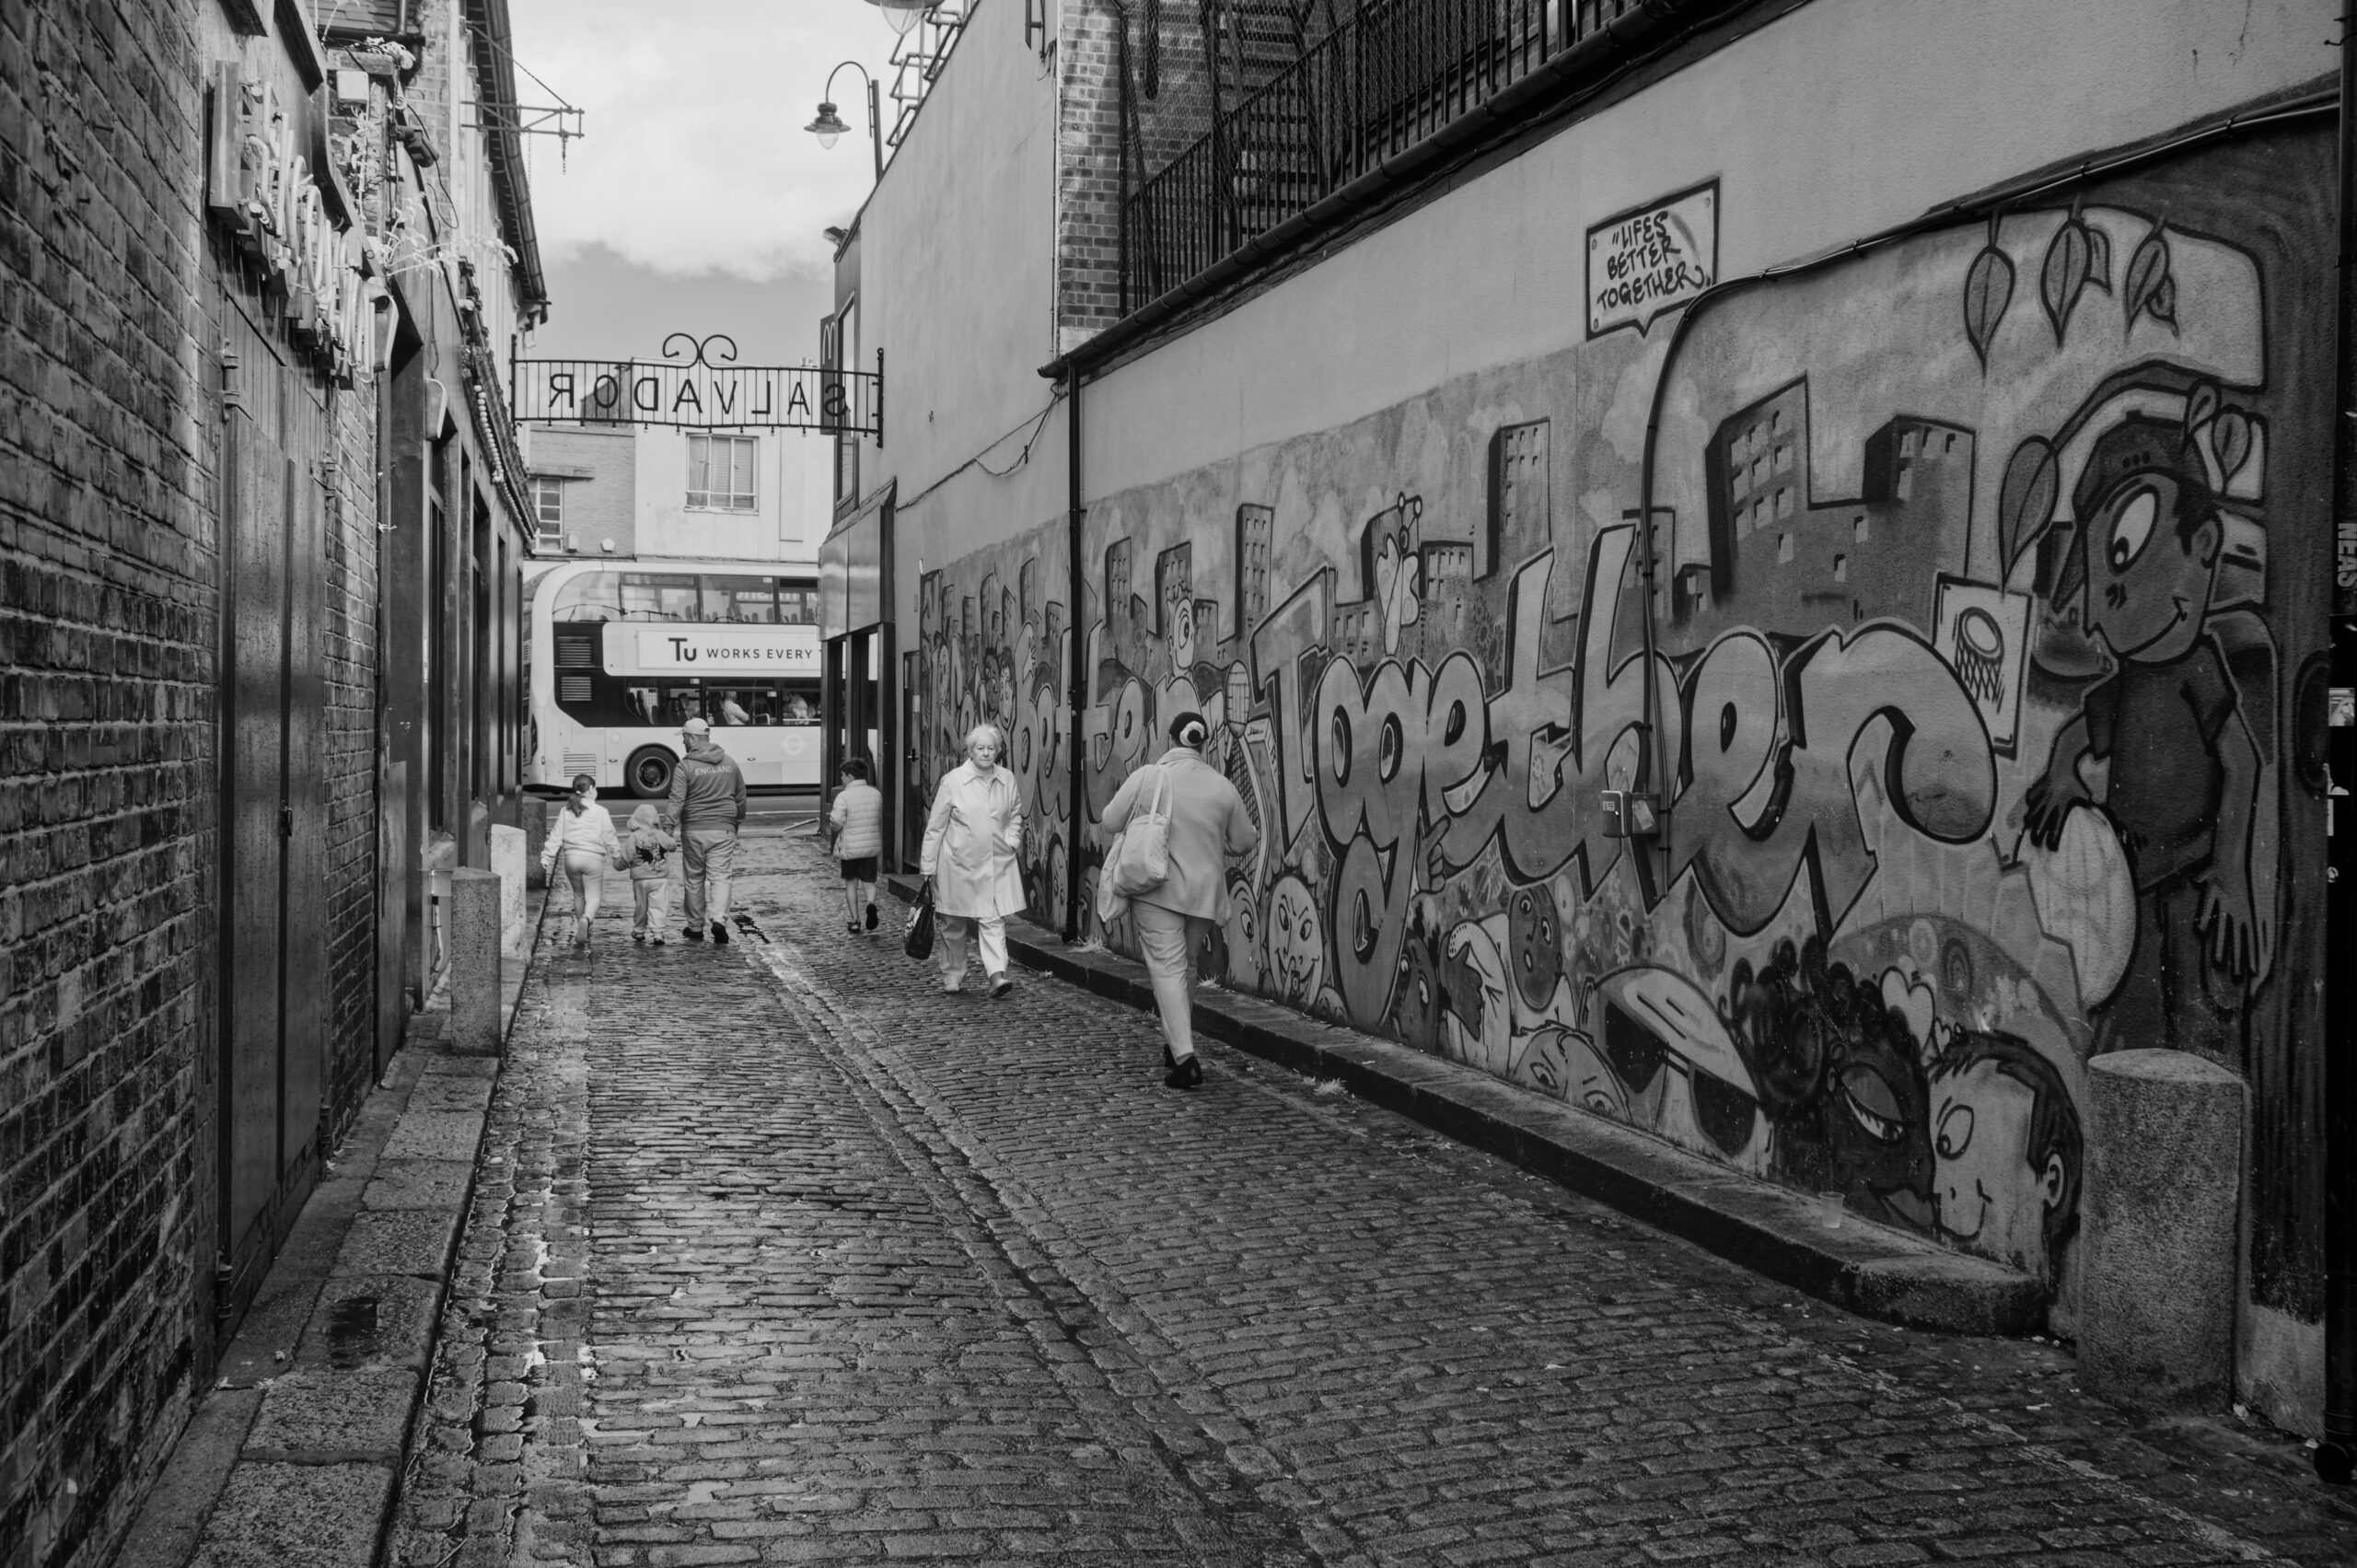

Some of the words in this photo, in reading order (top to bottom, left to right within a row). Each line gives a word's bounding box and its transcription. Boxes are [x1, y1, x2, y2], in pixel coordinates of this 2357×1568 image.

[1607, 235, 1681, 280] BETTER
[706, 648, 761, 659] WORKS
[767, 649, 812, 659] EVERY
[694, 765, 733, 776] ENGLAND
[1249, 521, 1997, 1028] Together
